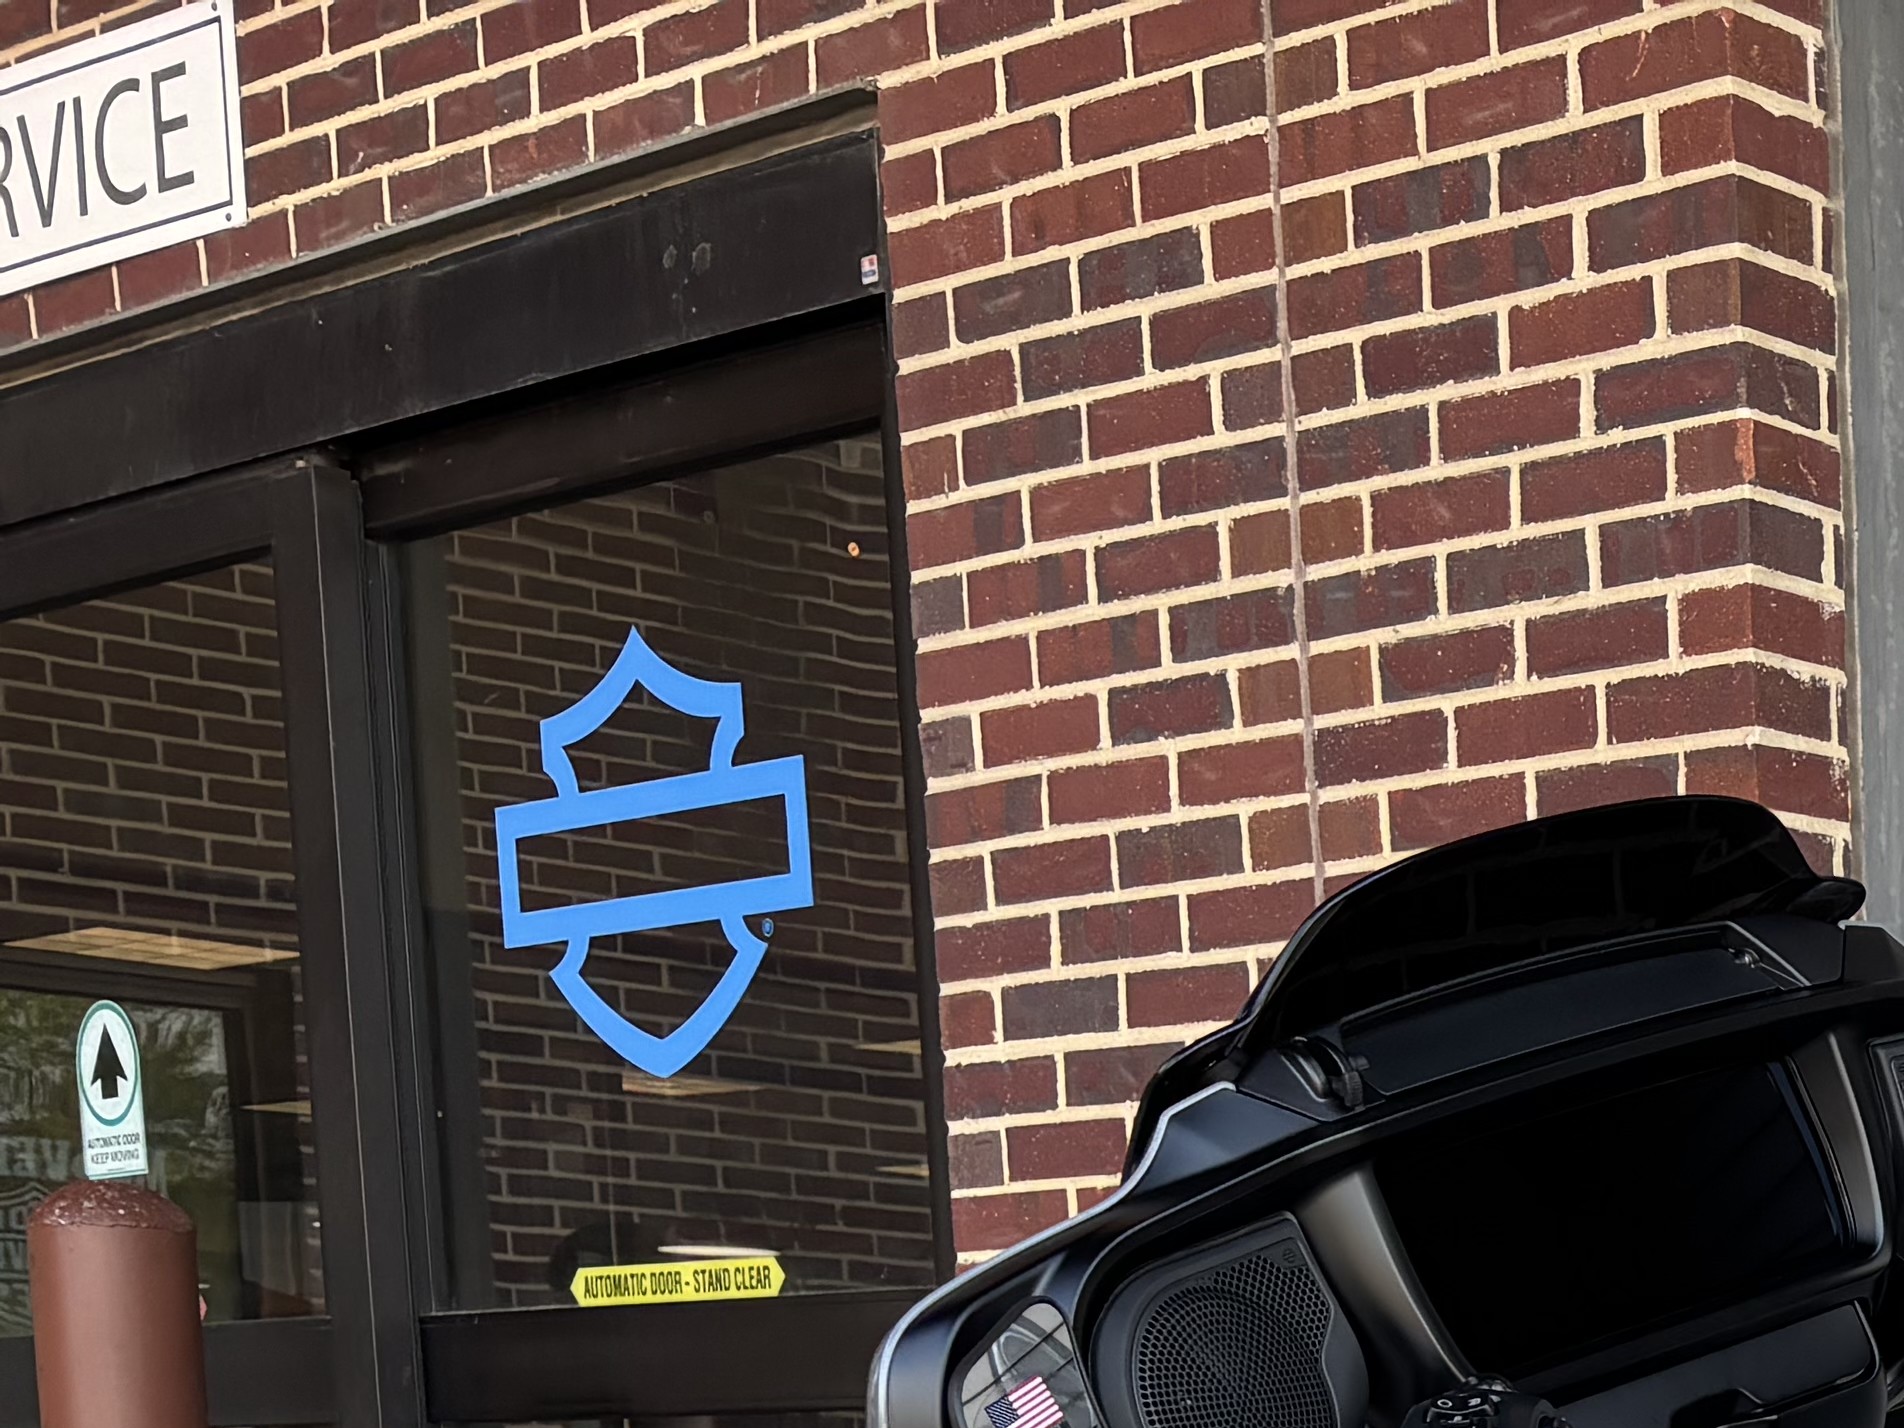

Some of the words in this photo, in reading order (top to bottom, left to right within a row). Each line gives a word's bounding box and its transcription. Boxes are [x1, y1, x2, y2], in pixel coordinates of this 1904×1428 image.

[91, 1151, 110, 1164] KEEP
[584, 1272, 647, 1299] AUTOMATIC
[650, 1270, 683, 1296] DOOR
[693, 1267, 731, 1293] STAND
[734, 1265, 772, 1291] CLEAR
